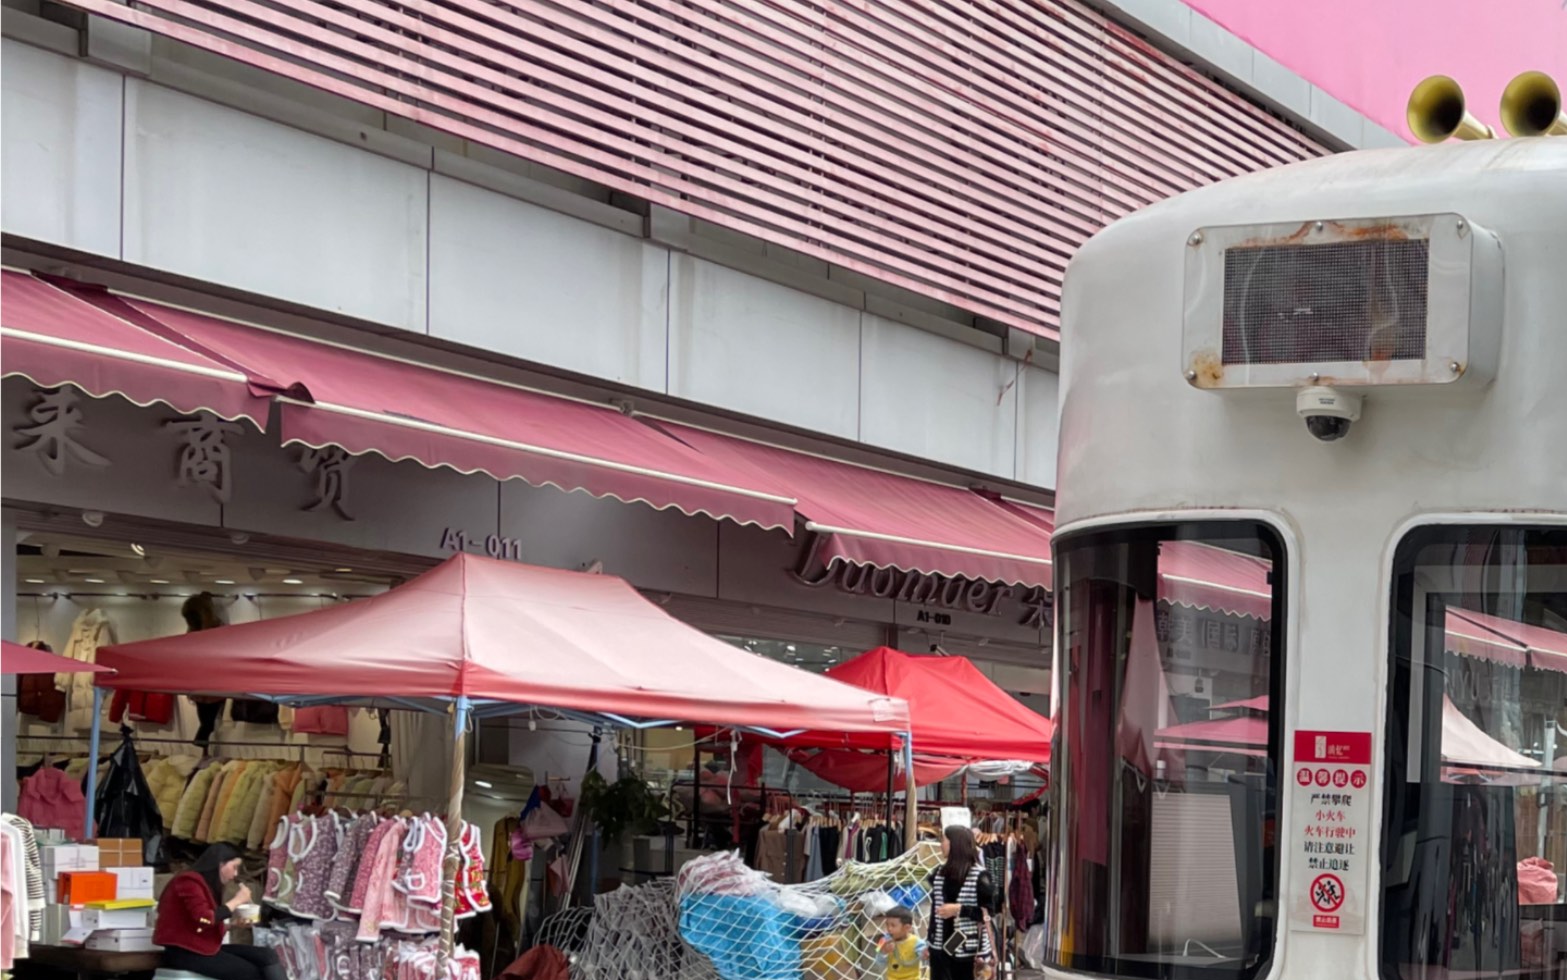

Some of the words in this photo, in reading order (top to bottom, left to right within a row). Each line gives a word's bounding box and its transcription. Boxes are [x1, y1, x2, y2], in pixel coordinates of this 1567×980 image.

[440, 527, 522, 560] A1-011
[1298, 769, 1366, 788] 温馨提示
[1310, 793, 1352, 806] 严禁攀爬
[1315, 809, 1346, 822] 小火车
[1304, 825, 1356, 839] 火车行驶中
[1304, 841, 1356, 855] 请注意避让
[1308, 857, 1350, 871] 禁止追逐
